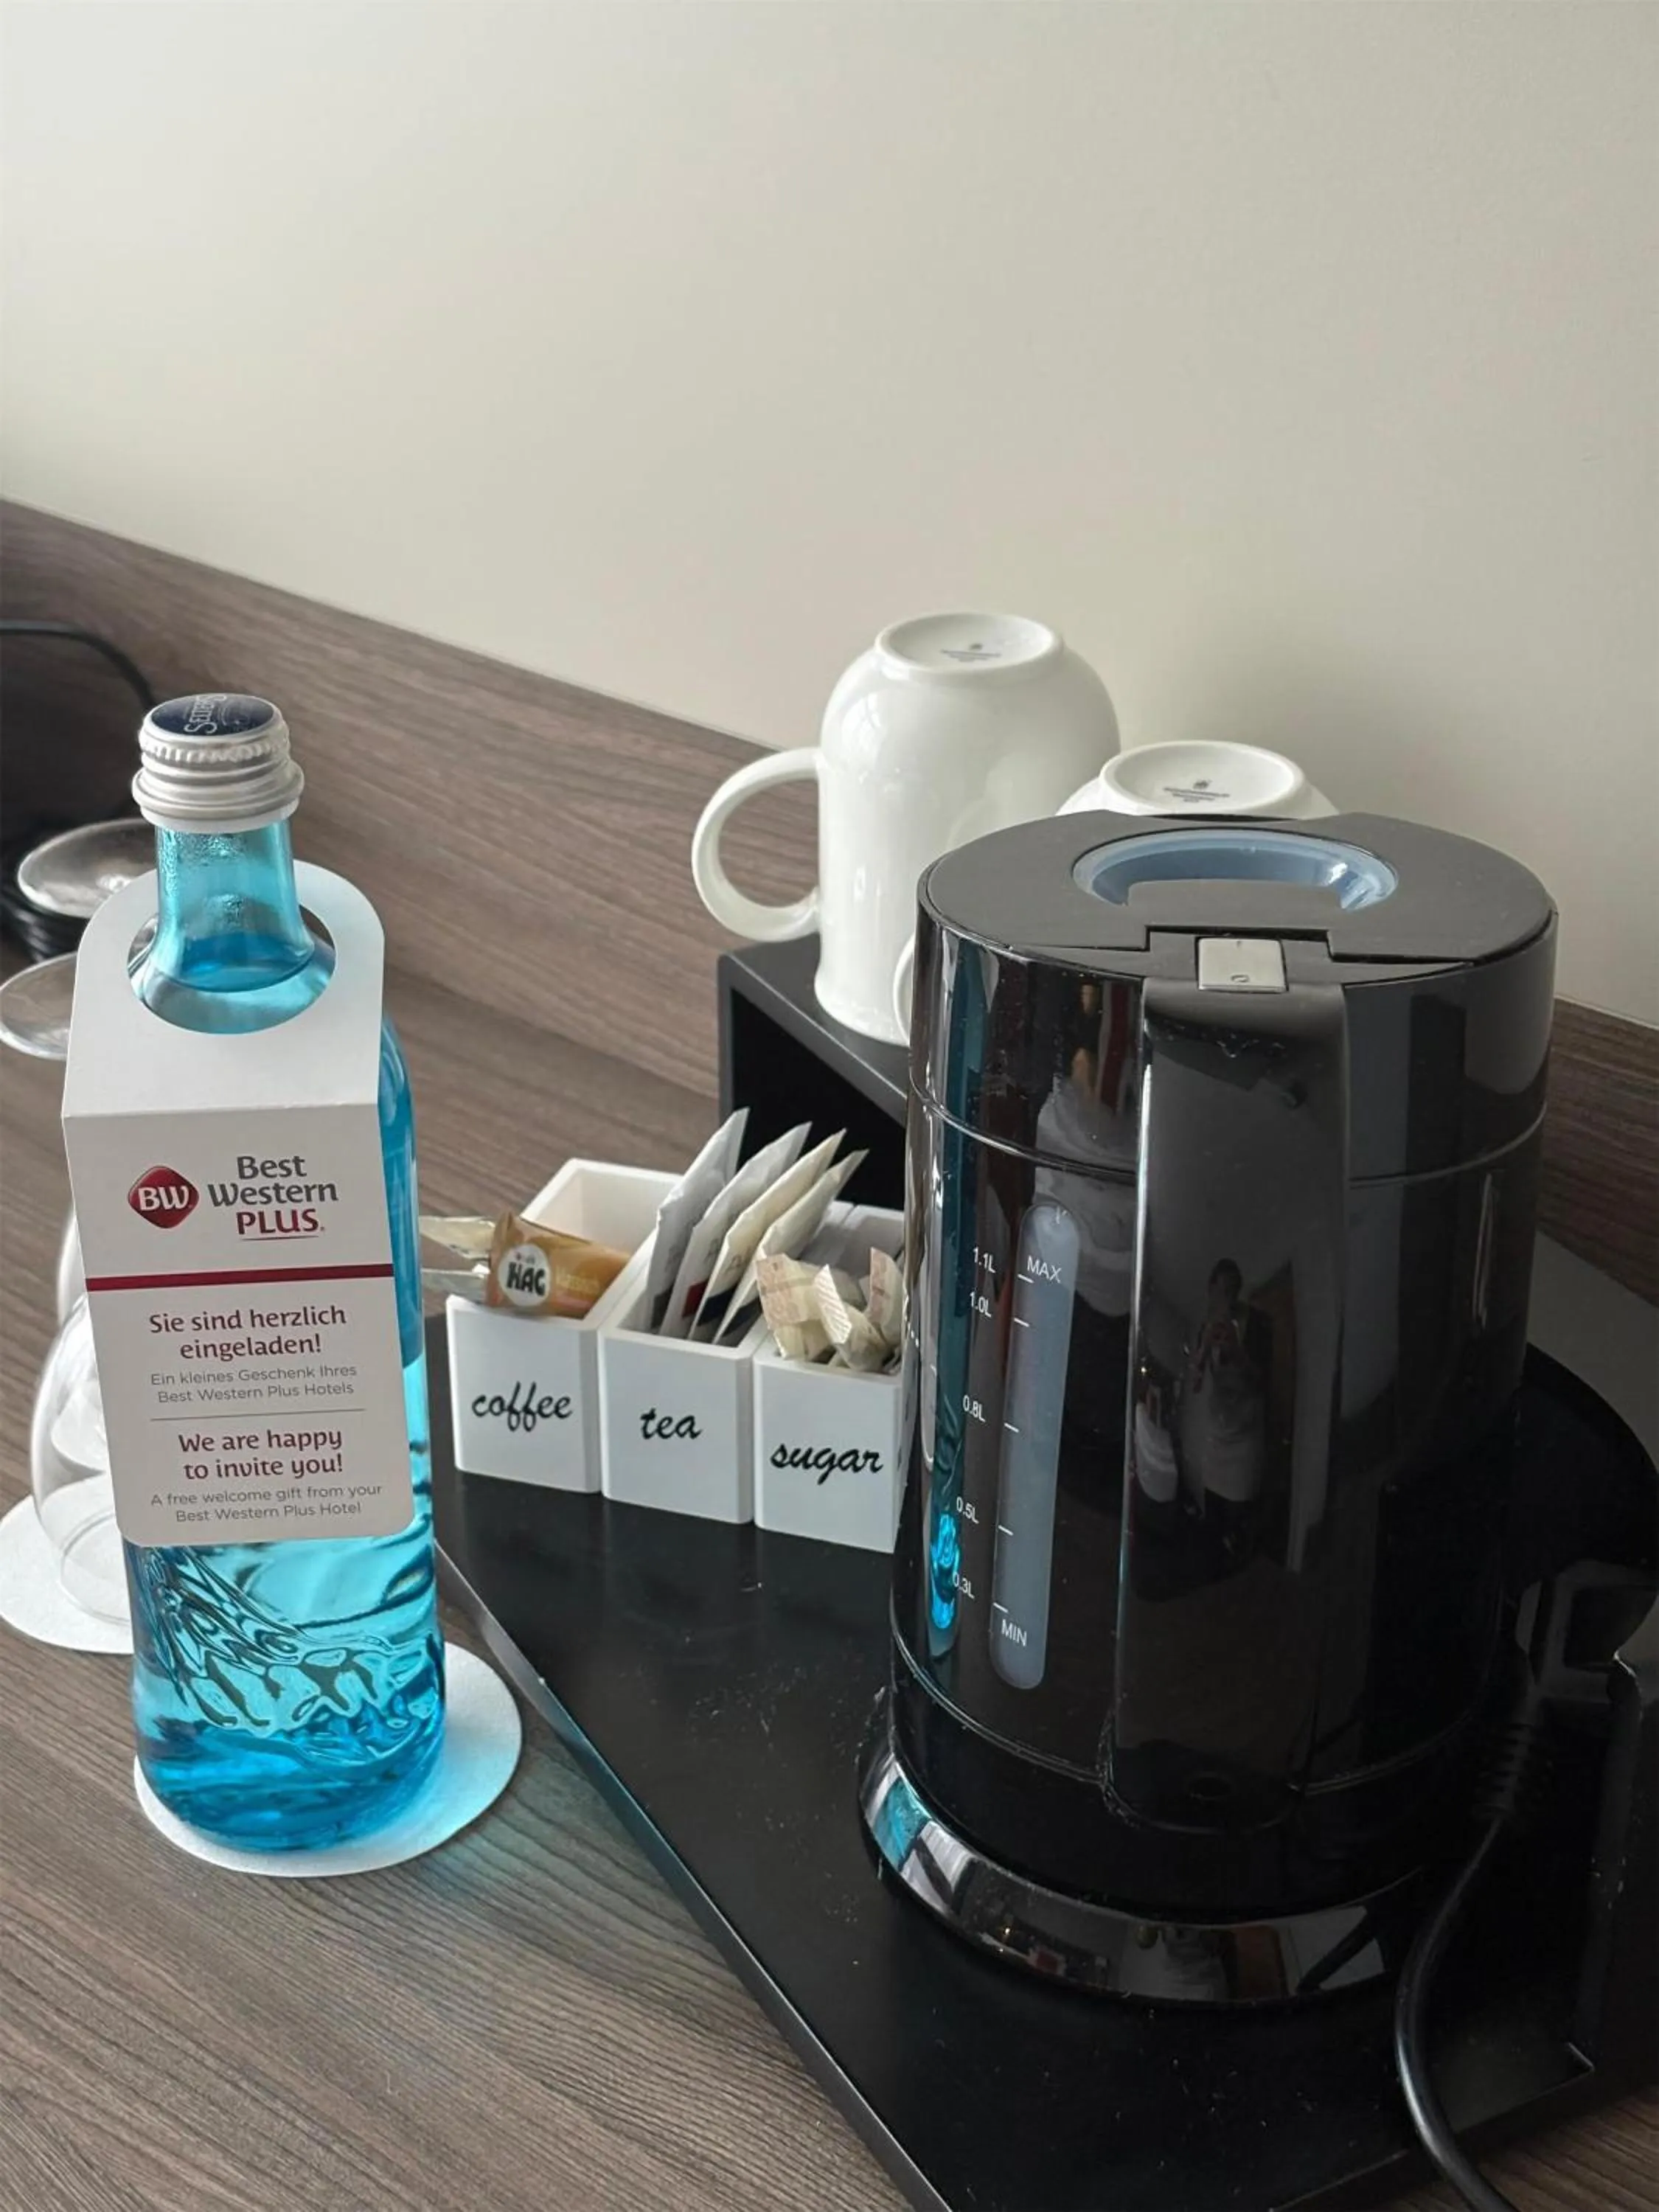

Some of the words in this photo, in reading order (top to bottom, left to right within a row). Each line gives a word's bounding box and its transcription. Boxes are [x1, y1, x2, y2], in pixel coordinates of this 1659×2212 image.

[237, 1155, 307, 1179] Best
[138, 1186, 189, 1211] BW
[207, 1183, 338, 1207] Western
[973, 1247, 995, 1273] 1.1L
[1027, 1255, 1063, 1284] MAX
[969, 1291, 992, 1318] 1.0L
[150, 1313, 184, 1333] Sie
[191, 1310, 243, 1331] sind
[250, 1305, 347, 1328] herzlich
[180, 1334, 321, 1361] eingeladen!
[151, 1374, 175, 1385] Ein
[180, 1371, 234, 1384] kleines
[238, 1366, 316, 1382] Geschenk
[319, 1366, 358, 1377] Ihres
[159, 1391, 192, 1403] Best
[197, 1386, 263, 1401] Western
[268, 1383, 299, 1398] Plus
[304, 1382, 354, 1396] Hotels
[471, 1382, 573, 1432] coffee
[962, 1395, 986, 1423] 0.8L
[639, 1408, 703, 1440] tea
[178, 1434, 215, 1452] We
[222, 1434, 260, 1450] are
[266, 1430, 343, 1452] happy
[184, 1464, 209, 1480] to
[215, 1458, 283, 1478] invite
[291, 1453, 343, 1479] you!
[770, 1441, 885, 1485] sugar
[150, 1495, 163, 1506] A
[167, 1493, 198, 1505] free
[202, 1490, 271, 1503] welcome
[275, 1488, 302, 1503] gift
[306, 1486, 344, 1498] from
[347, 1486, 383, 1498] your
[175, 1510, 210, 1523] Best
[214, 1506, 279, 1520] Western
[284, 1504, 316, 1517] Plus
[319, 1502, 362, 1515] Hotel
[956, 1496, 979, 1524] 0.5L
[953, 1571, 975, 1599] 0.3L
[1001, 1618, 1027, 1646] MIN
